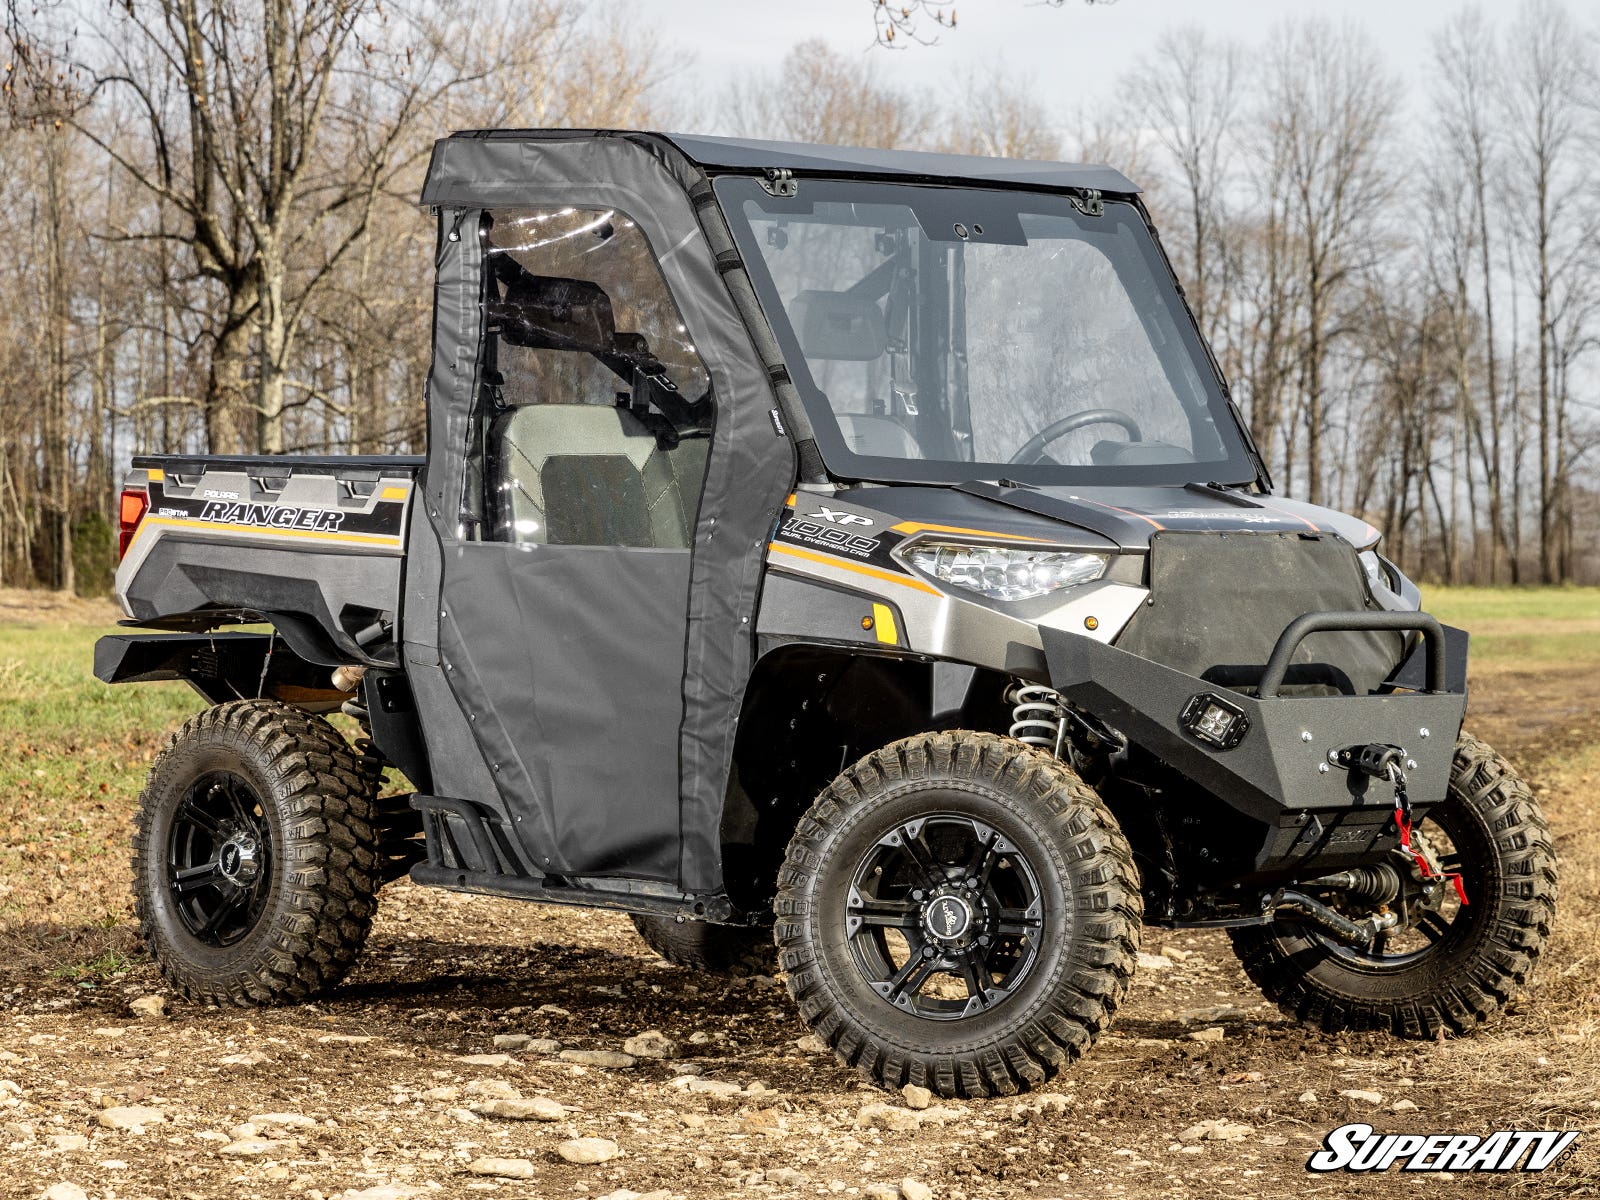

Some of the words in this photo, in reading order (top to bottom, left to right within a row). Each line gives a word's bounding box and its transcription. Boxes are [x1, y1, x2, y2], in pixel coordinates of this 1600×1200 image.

[203, 490, 239, 500] POLARIS
[199, 501, 344, 532] RANGER
[803, 505, 875, 526] XP
[780, 530, 803, 540] DUAL
[804, 536, 849, 552] OVERHEAD
[849, 548, 871, 558] CAM
[782, 517, 880, 552] 1000
